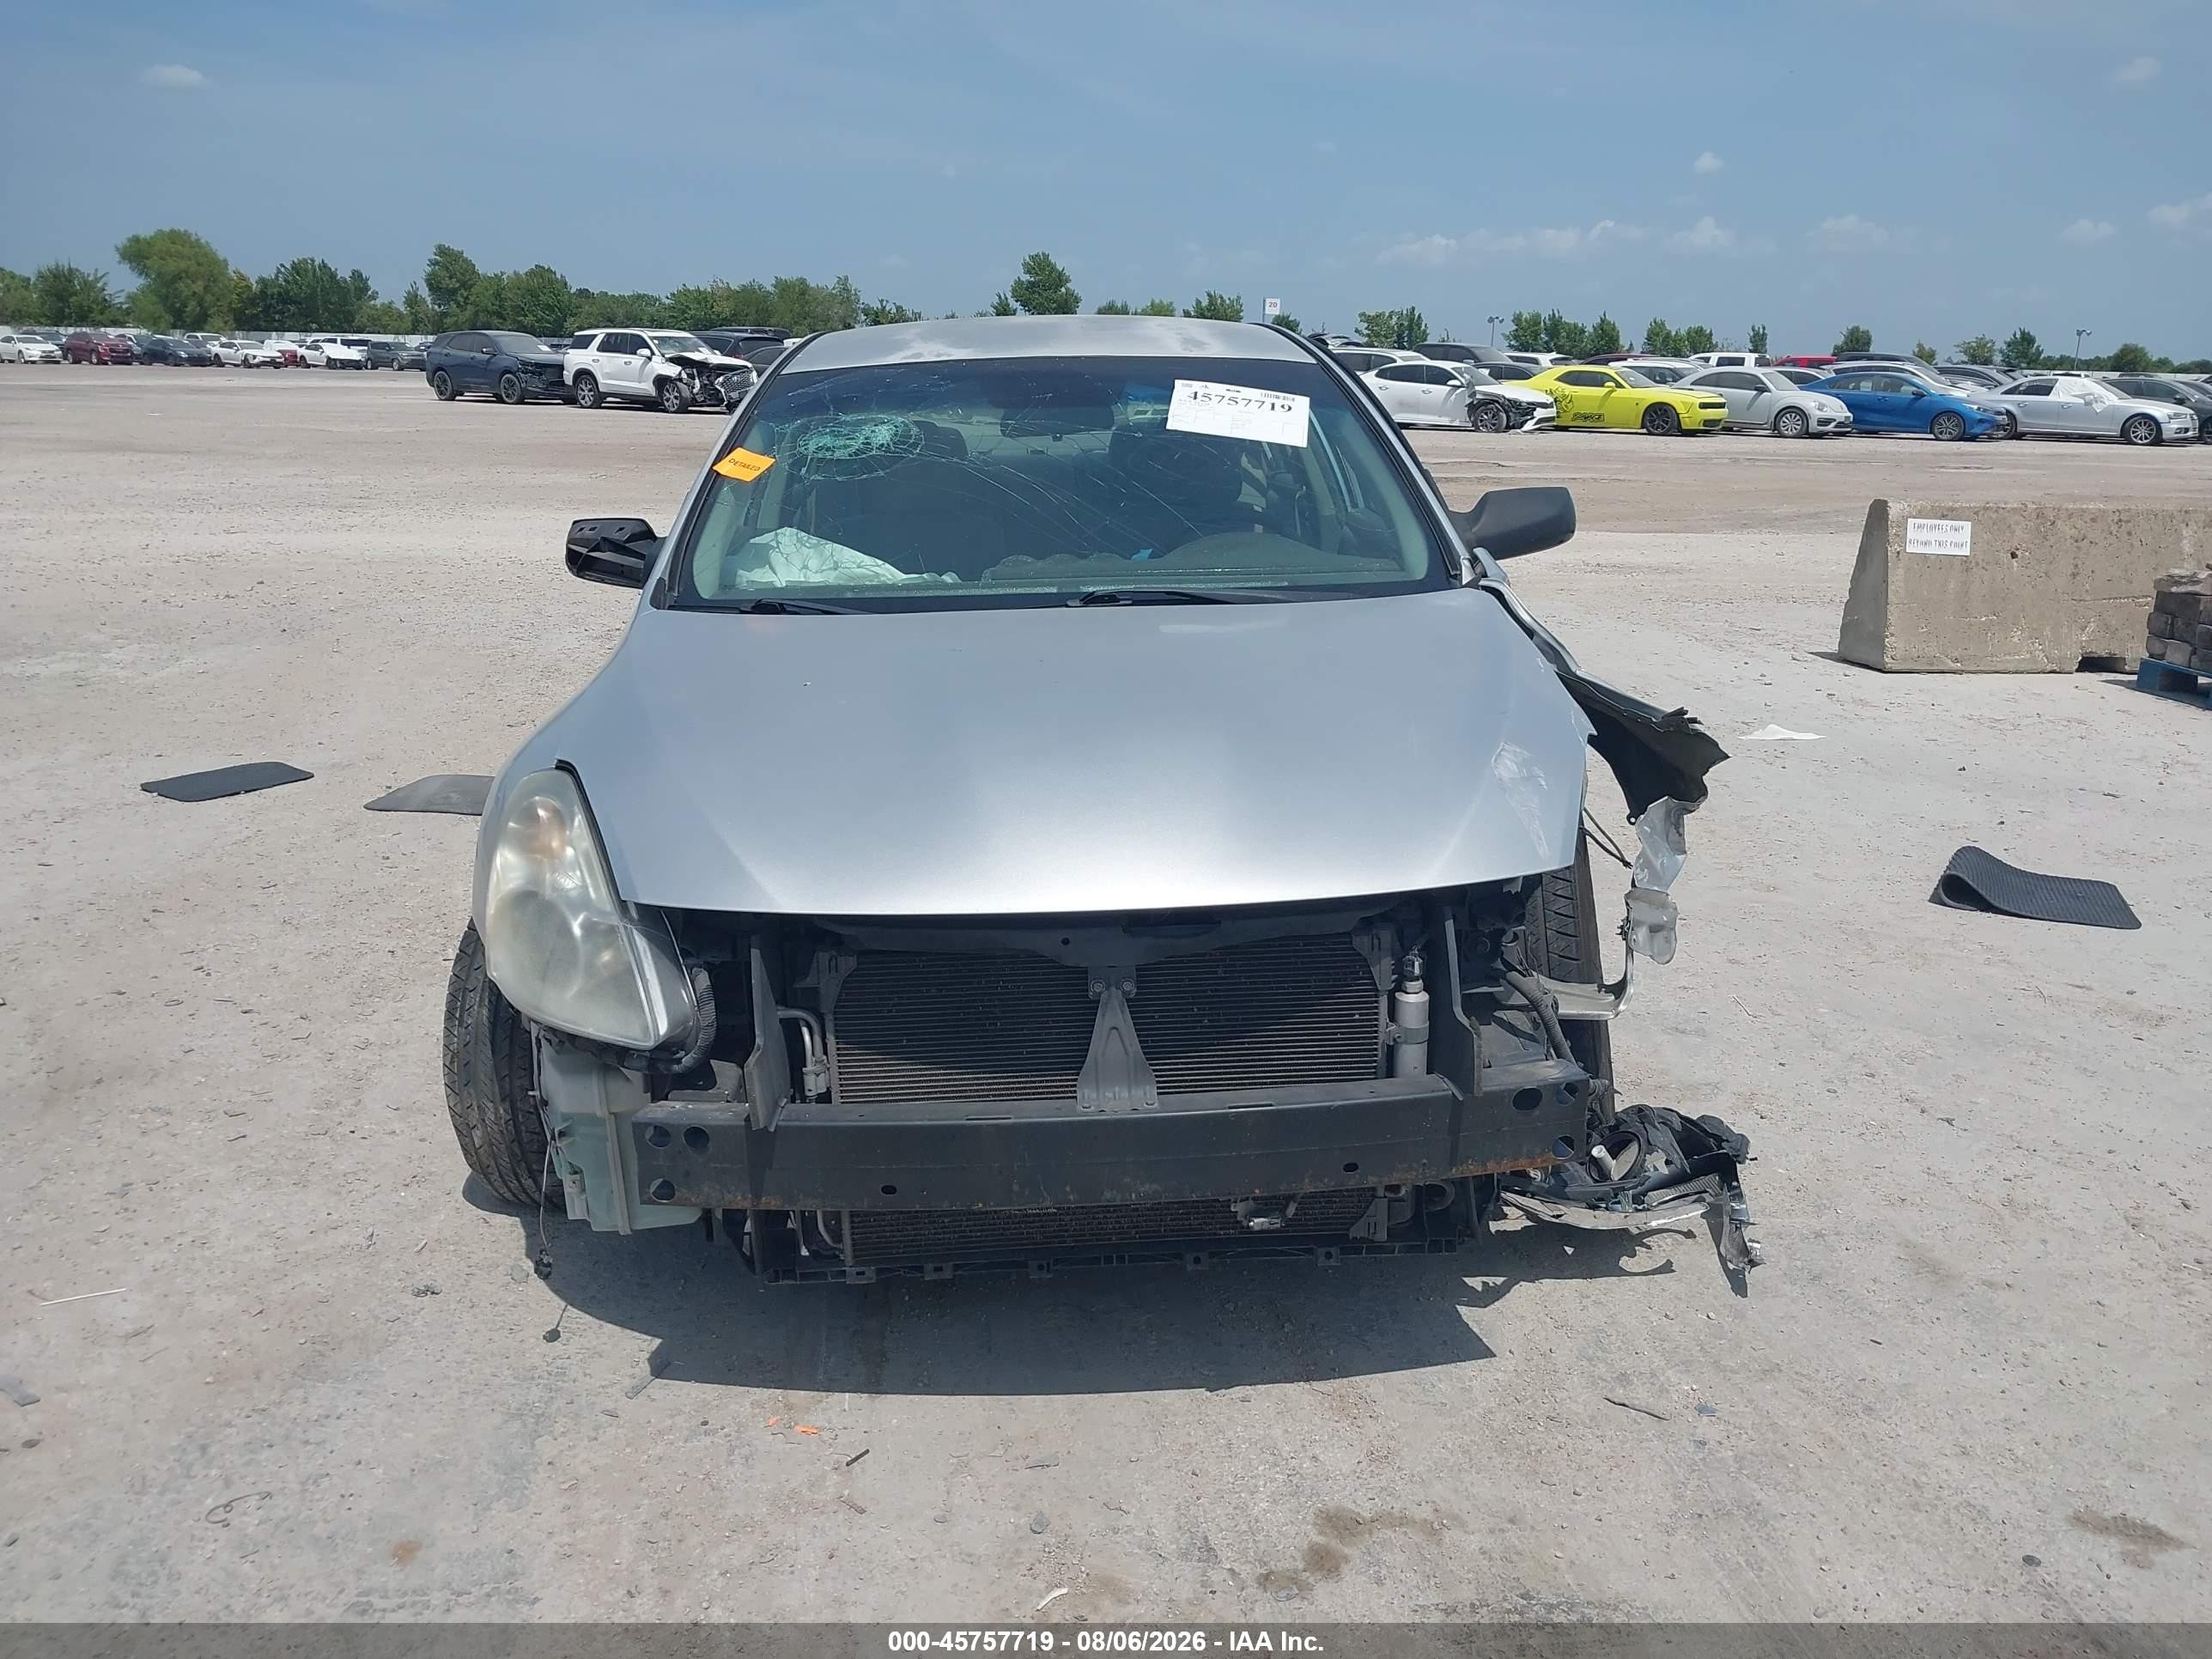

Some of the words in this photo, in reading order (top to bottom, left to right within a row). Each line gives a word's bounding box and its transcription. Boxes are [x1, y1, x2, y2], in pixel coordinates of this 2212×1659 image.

[1188, 391, 1293, 413] 45757719
[728, 458, 762, 471] DETAILED
[1912, 522, 1948, 533] EMPLOYEES
[1949, 524, 1965, 533] ONLY
[1908, 538, 1933, 549] BEYOND
[1934, 538, 1948, 550] THIS
[1949, 540, 1968, 550] POINT
